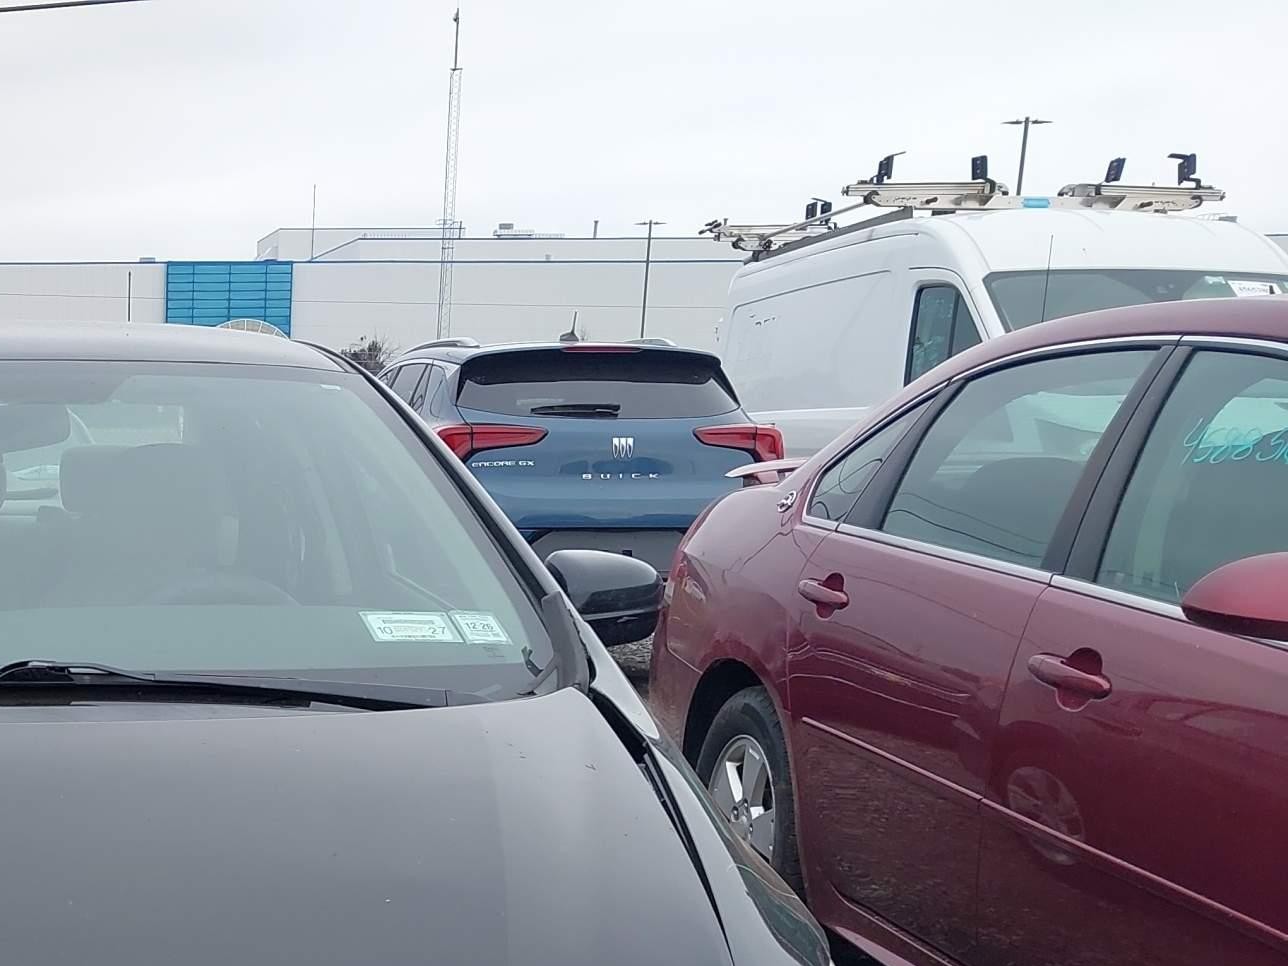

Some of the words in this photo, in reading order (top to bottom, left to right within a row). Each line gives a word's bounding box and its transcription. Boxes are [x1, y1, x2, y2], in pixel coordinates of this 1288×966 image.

[471, 460, 516, 468] ENCORE
[582, 472, 659, 480] BUICK
[377, 626, 393, 635] 10
[428, 626, 445, 635] 27
